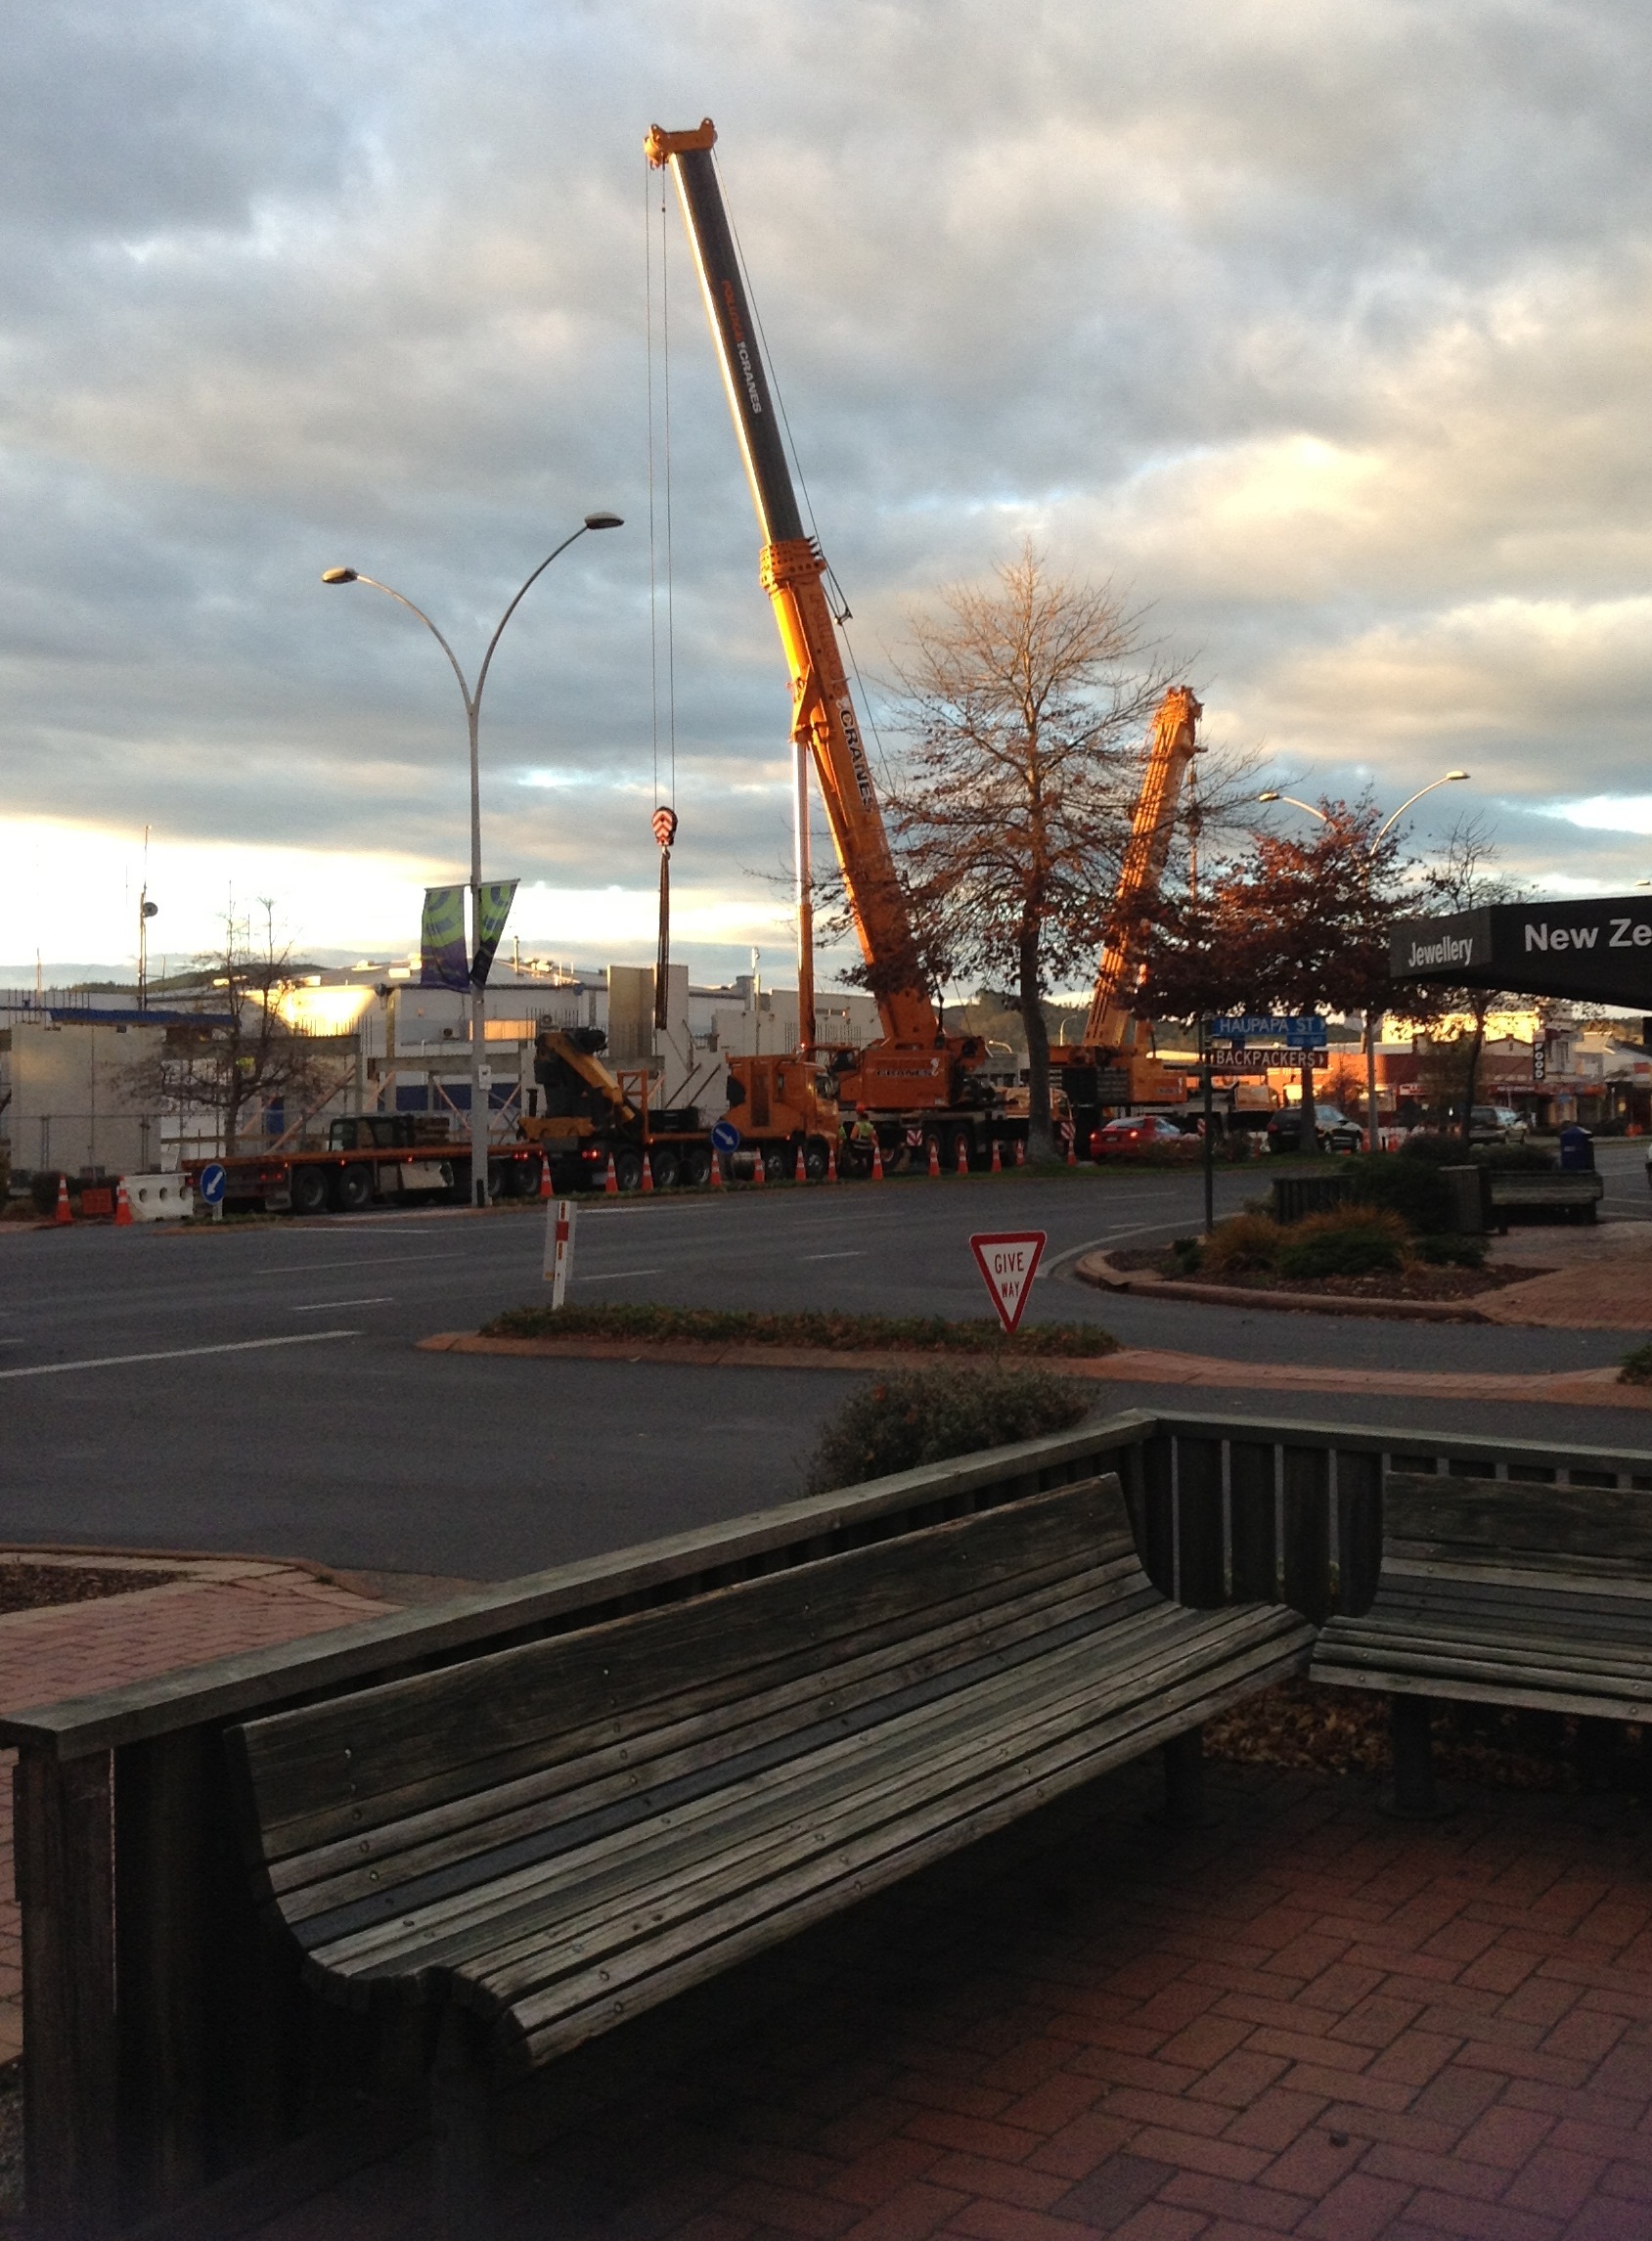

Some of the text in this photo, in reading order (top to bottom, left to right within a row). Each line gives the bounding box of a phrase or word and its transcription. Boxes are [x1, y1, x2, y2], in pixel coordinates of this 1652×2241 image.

[739, 351, 762, 414] CRANES
[1525, 918, 1652, 952] New Ze
[1408, 935, 1474, 967] Jewellery
[1220, 1017, 1315, 1033] HAUPAPA ST
[1216, 1050, 1317, 1067] BACKPACKERS
[994, 1251, 1024, 1275] GIVE
[1001, 1281, 1019, 1298] WAY
